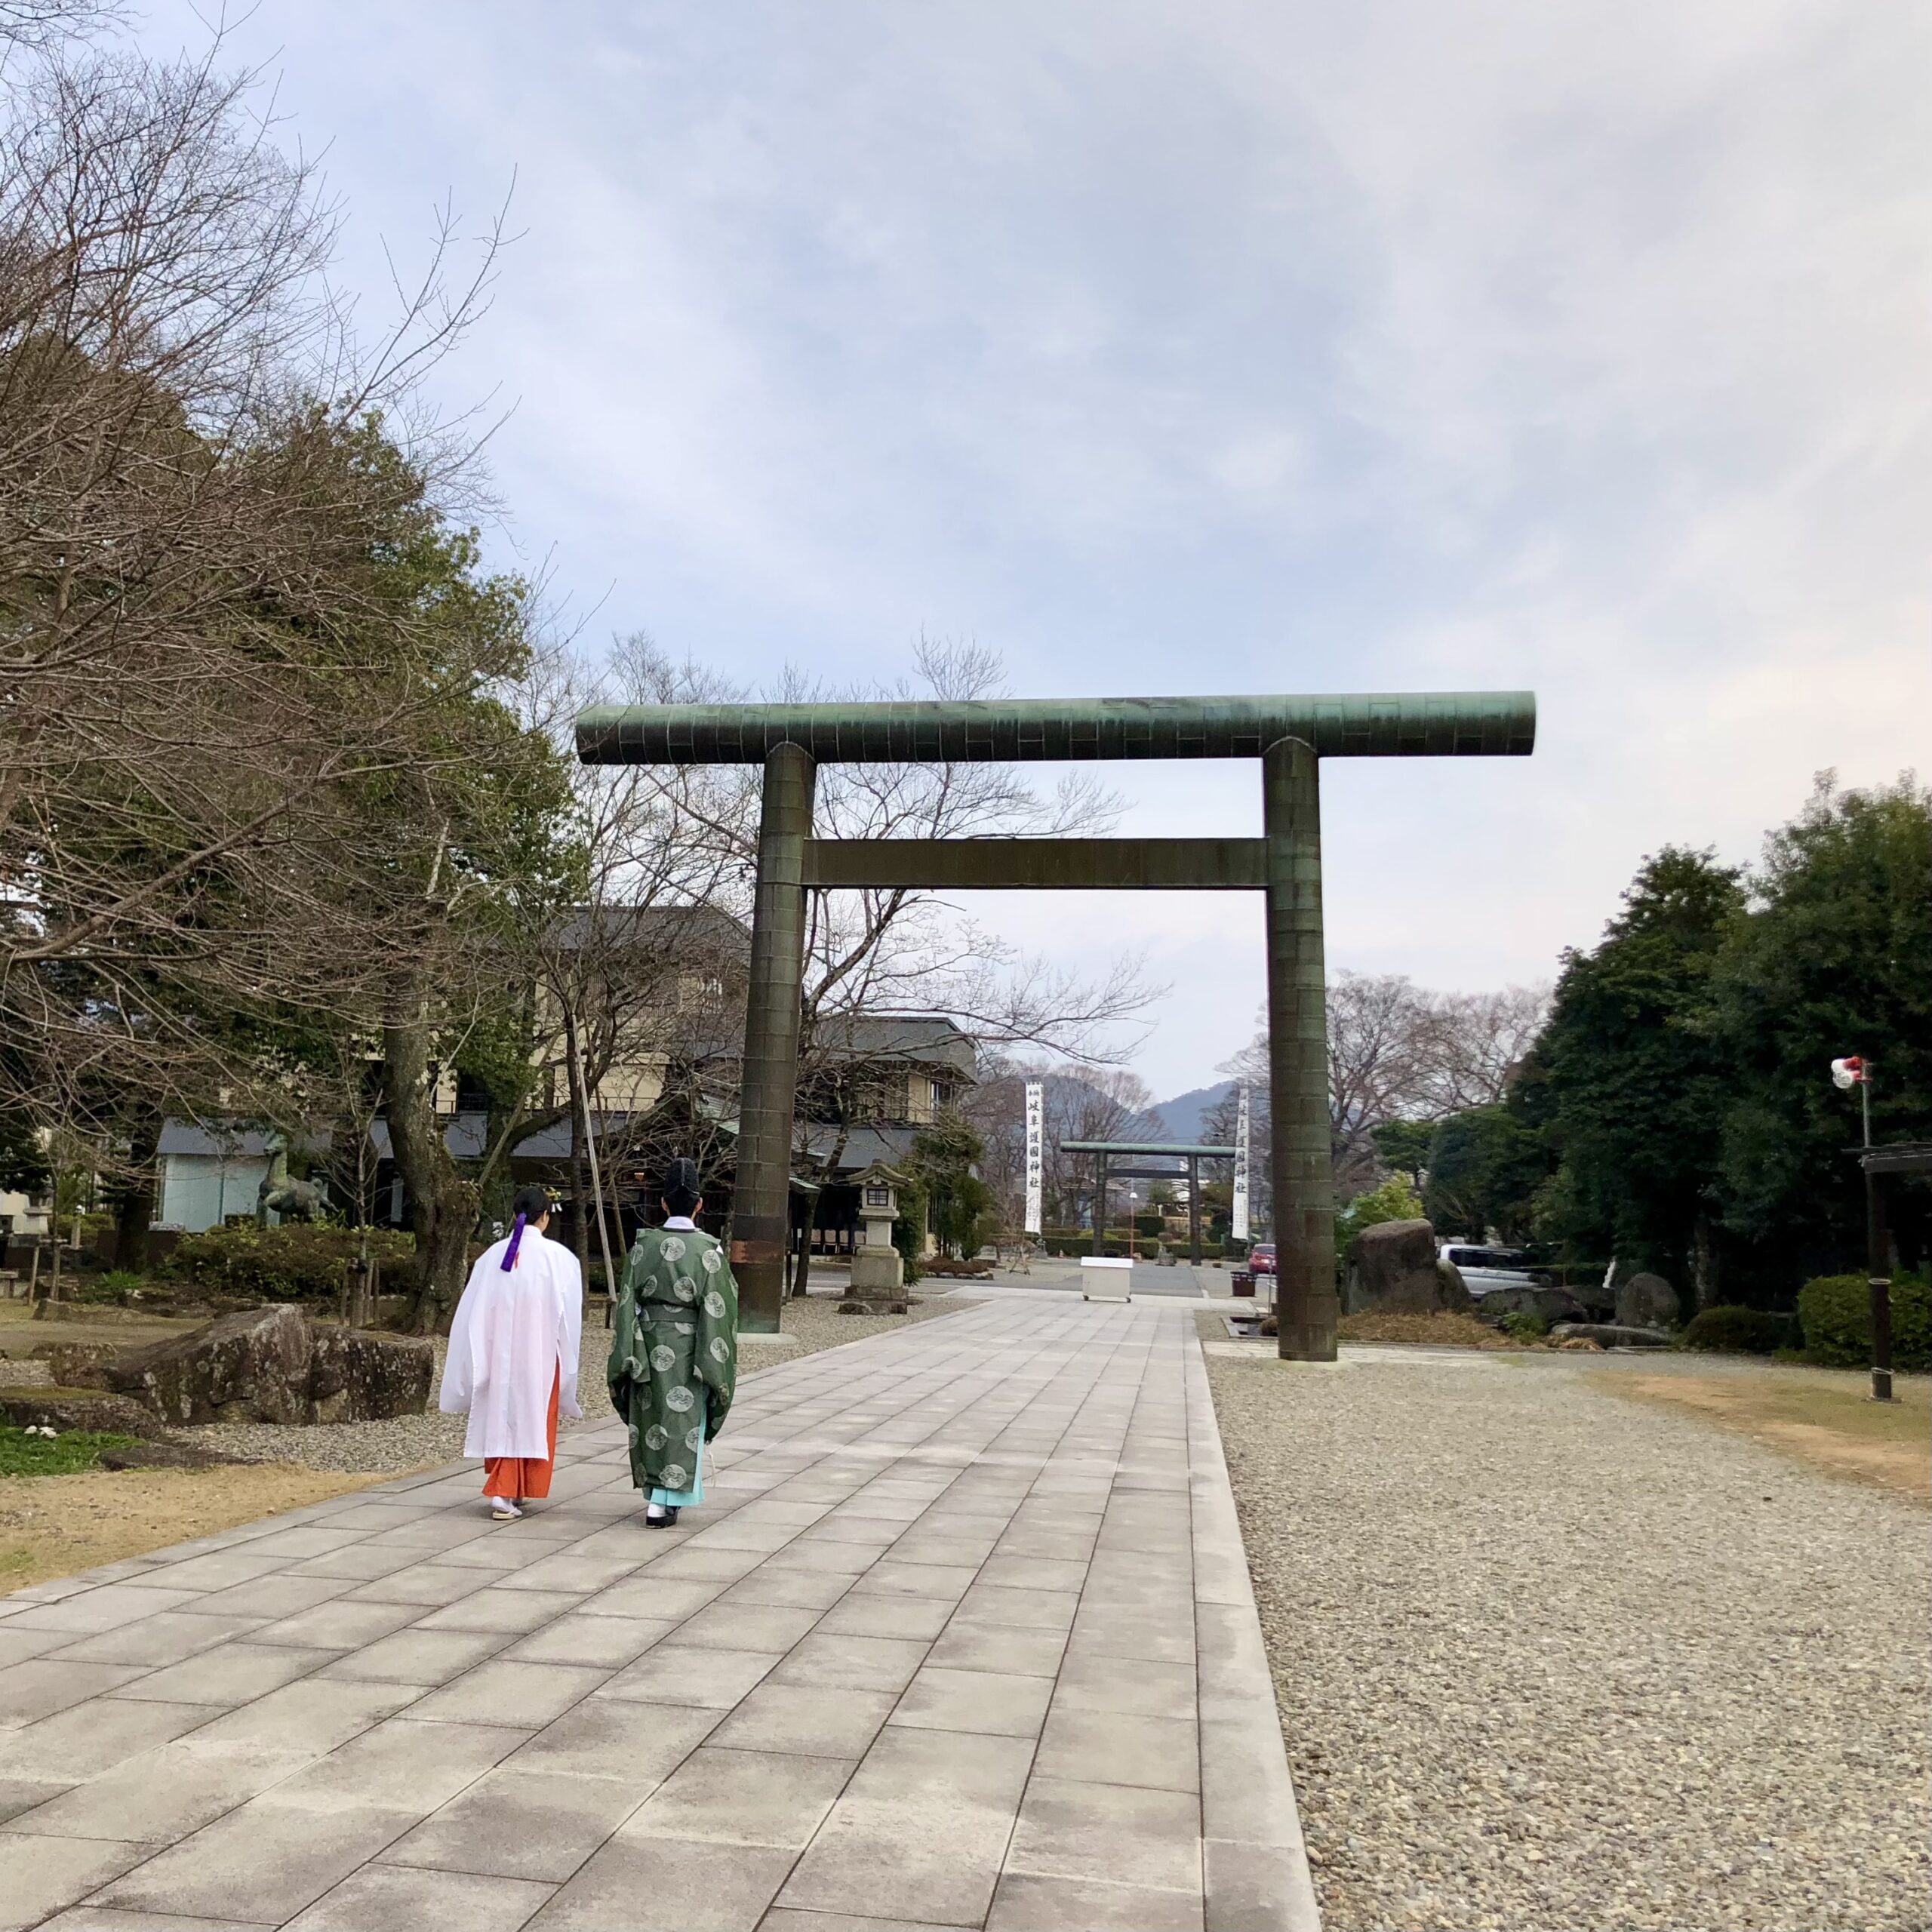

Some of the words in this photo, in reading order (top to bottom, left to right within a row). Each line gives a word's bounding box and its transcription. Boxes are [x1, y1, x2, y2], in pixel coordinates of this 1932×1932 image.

[1028, 1100, 1040, 1188] 岐阜護國神社
